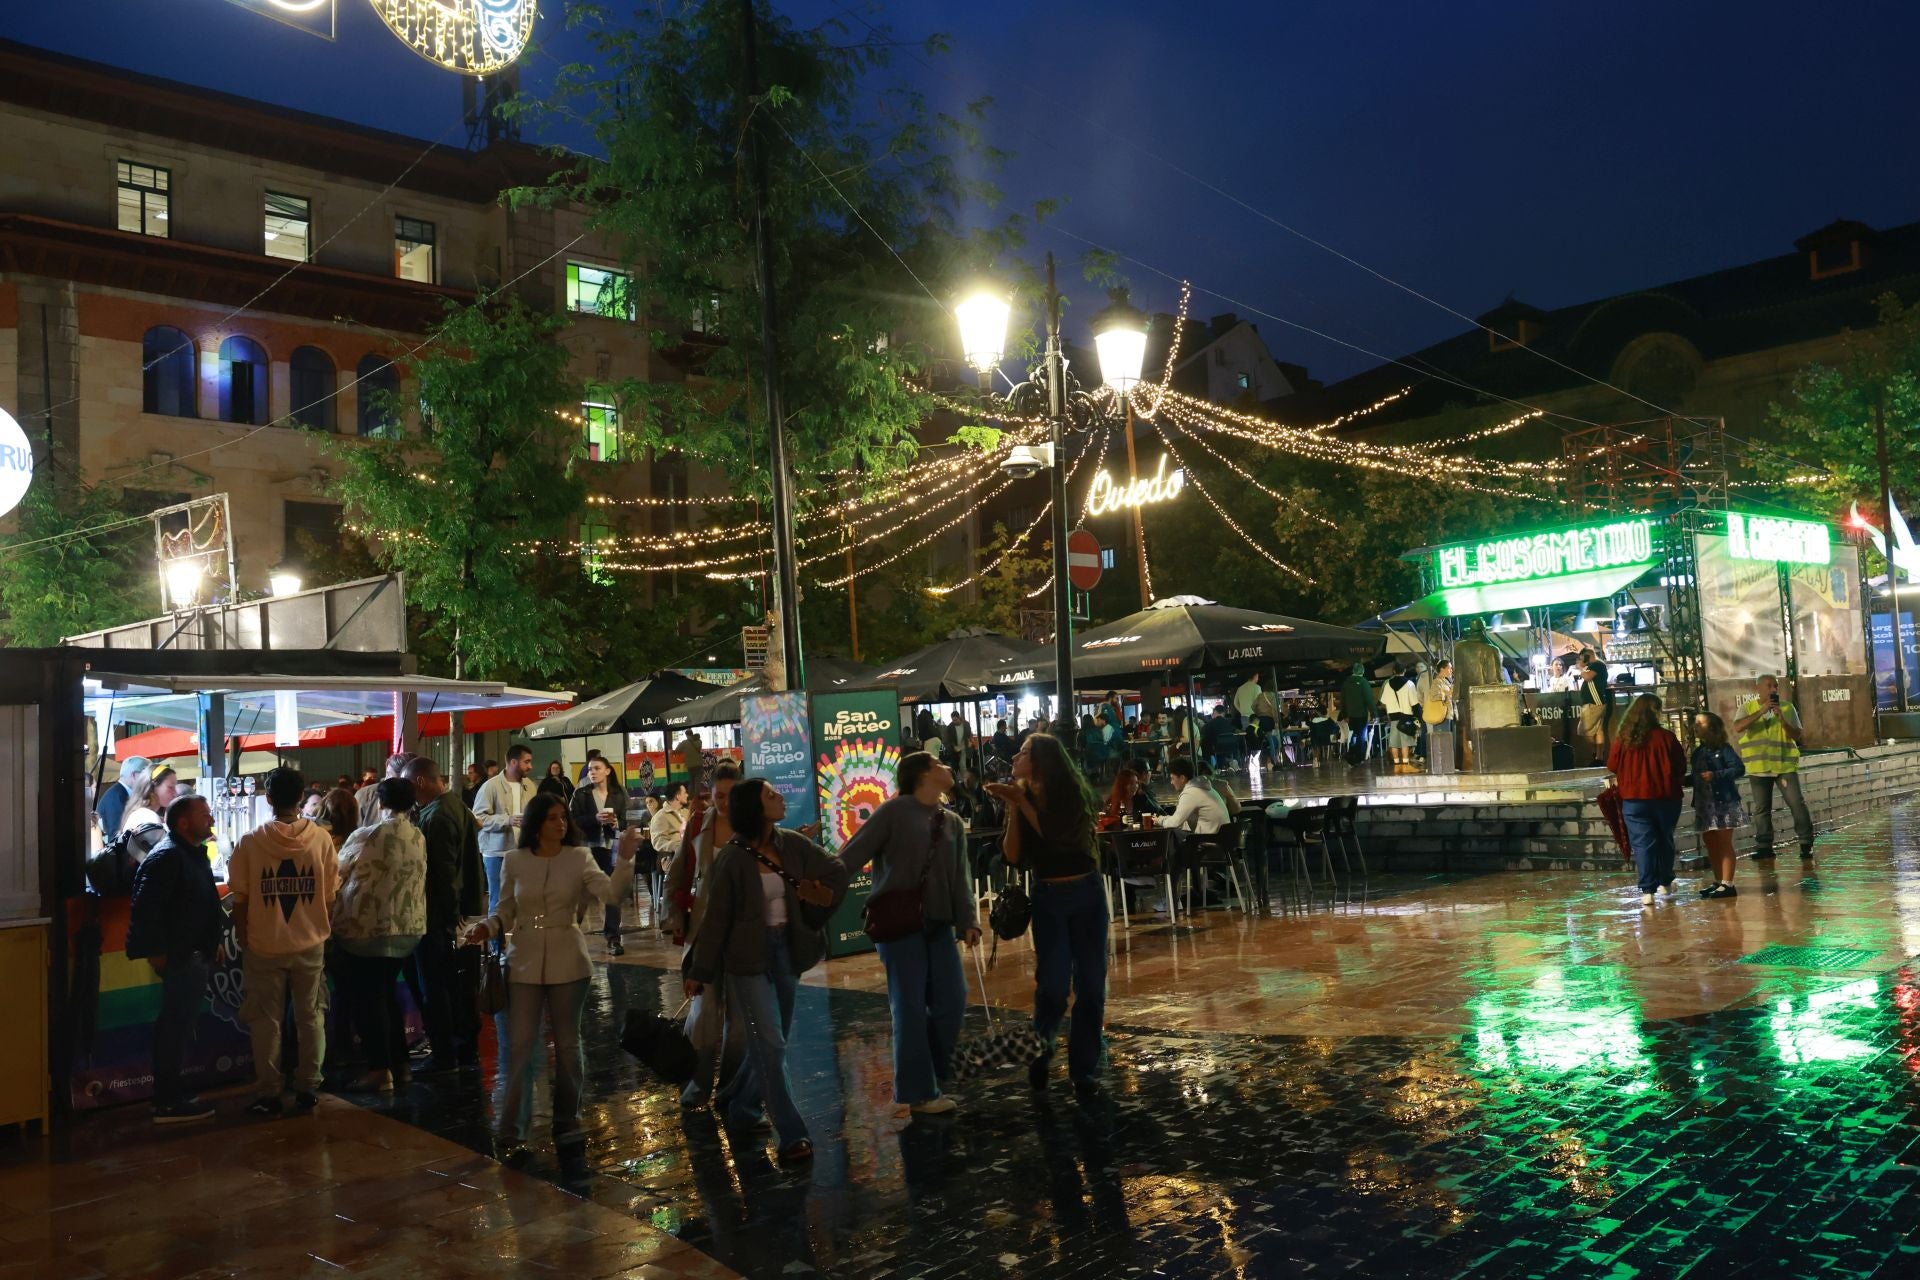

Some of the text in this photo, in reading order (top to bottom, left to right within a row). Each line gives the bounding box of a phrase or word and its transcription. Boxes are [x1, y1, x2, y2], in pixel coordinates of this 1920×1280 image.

[1089, 453, 1183, 516] Oviedo
[1440, 545, 1476, 587] EL
[1229, 647, 1264, 659] LA SALVE
[1000, 670, 1035, 683] LA SALVE
[836, 710, 877, 724] San
[824, 719, 891, 736] Mateo
[760, 741, 792, 754] San
[751, 751, 805, 766] Mateo
[261, 877, 316, 894] QUIKSILVER
